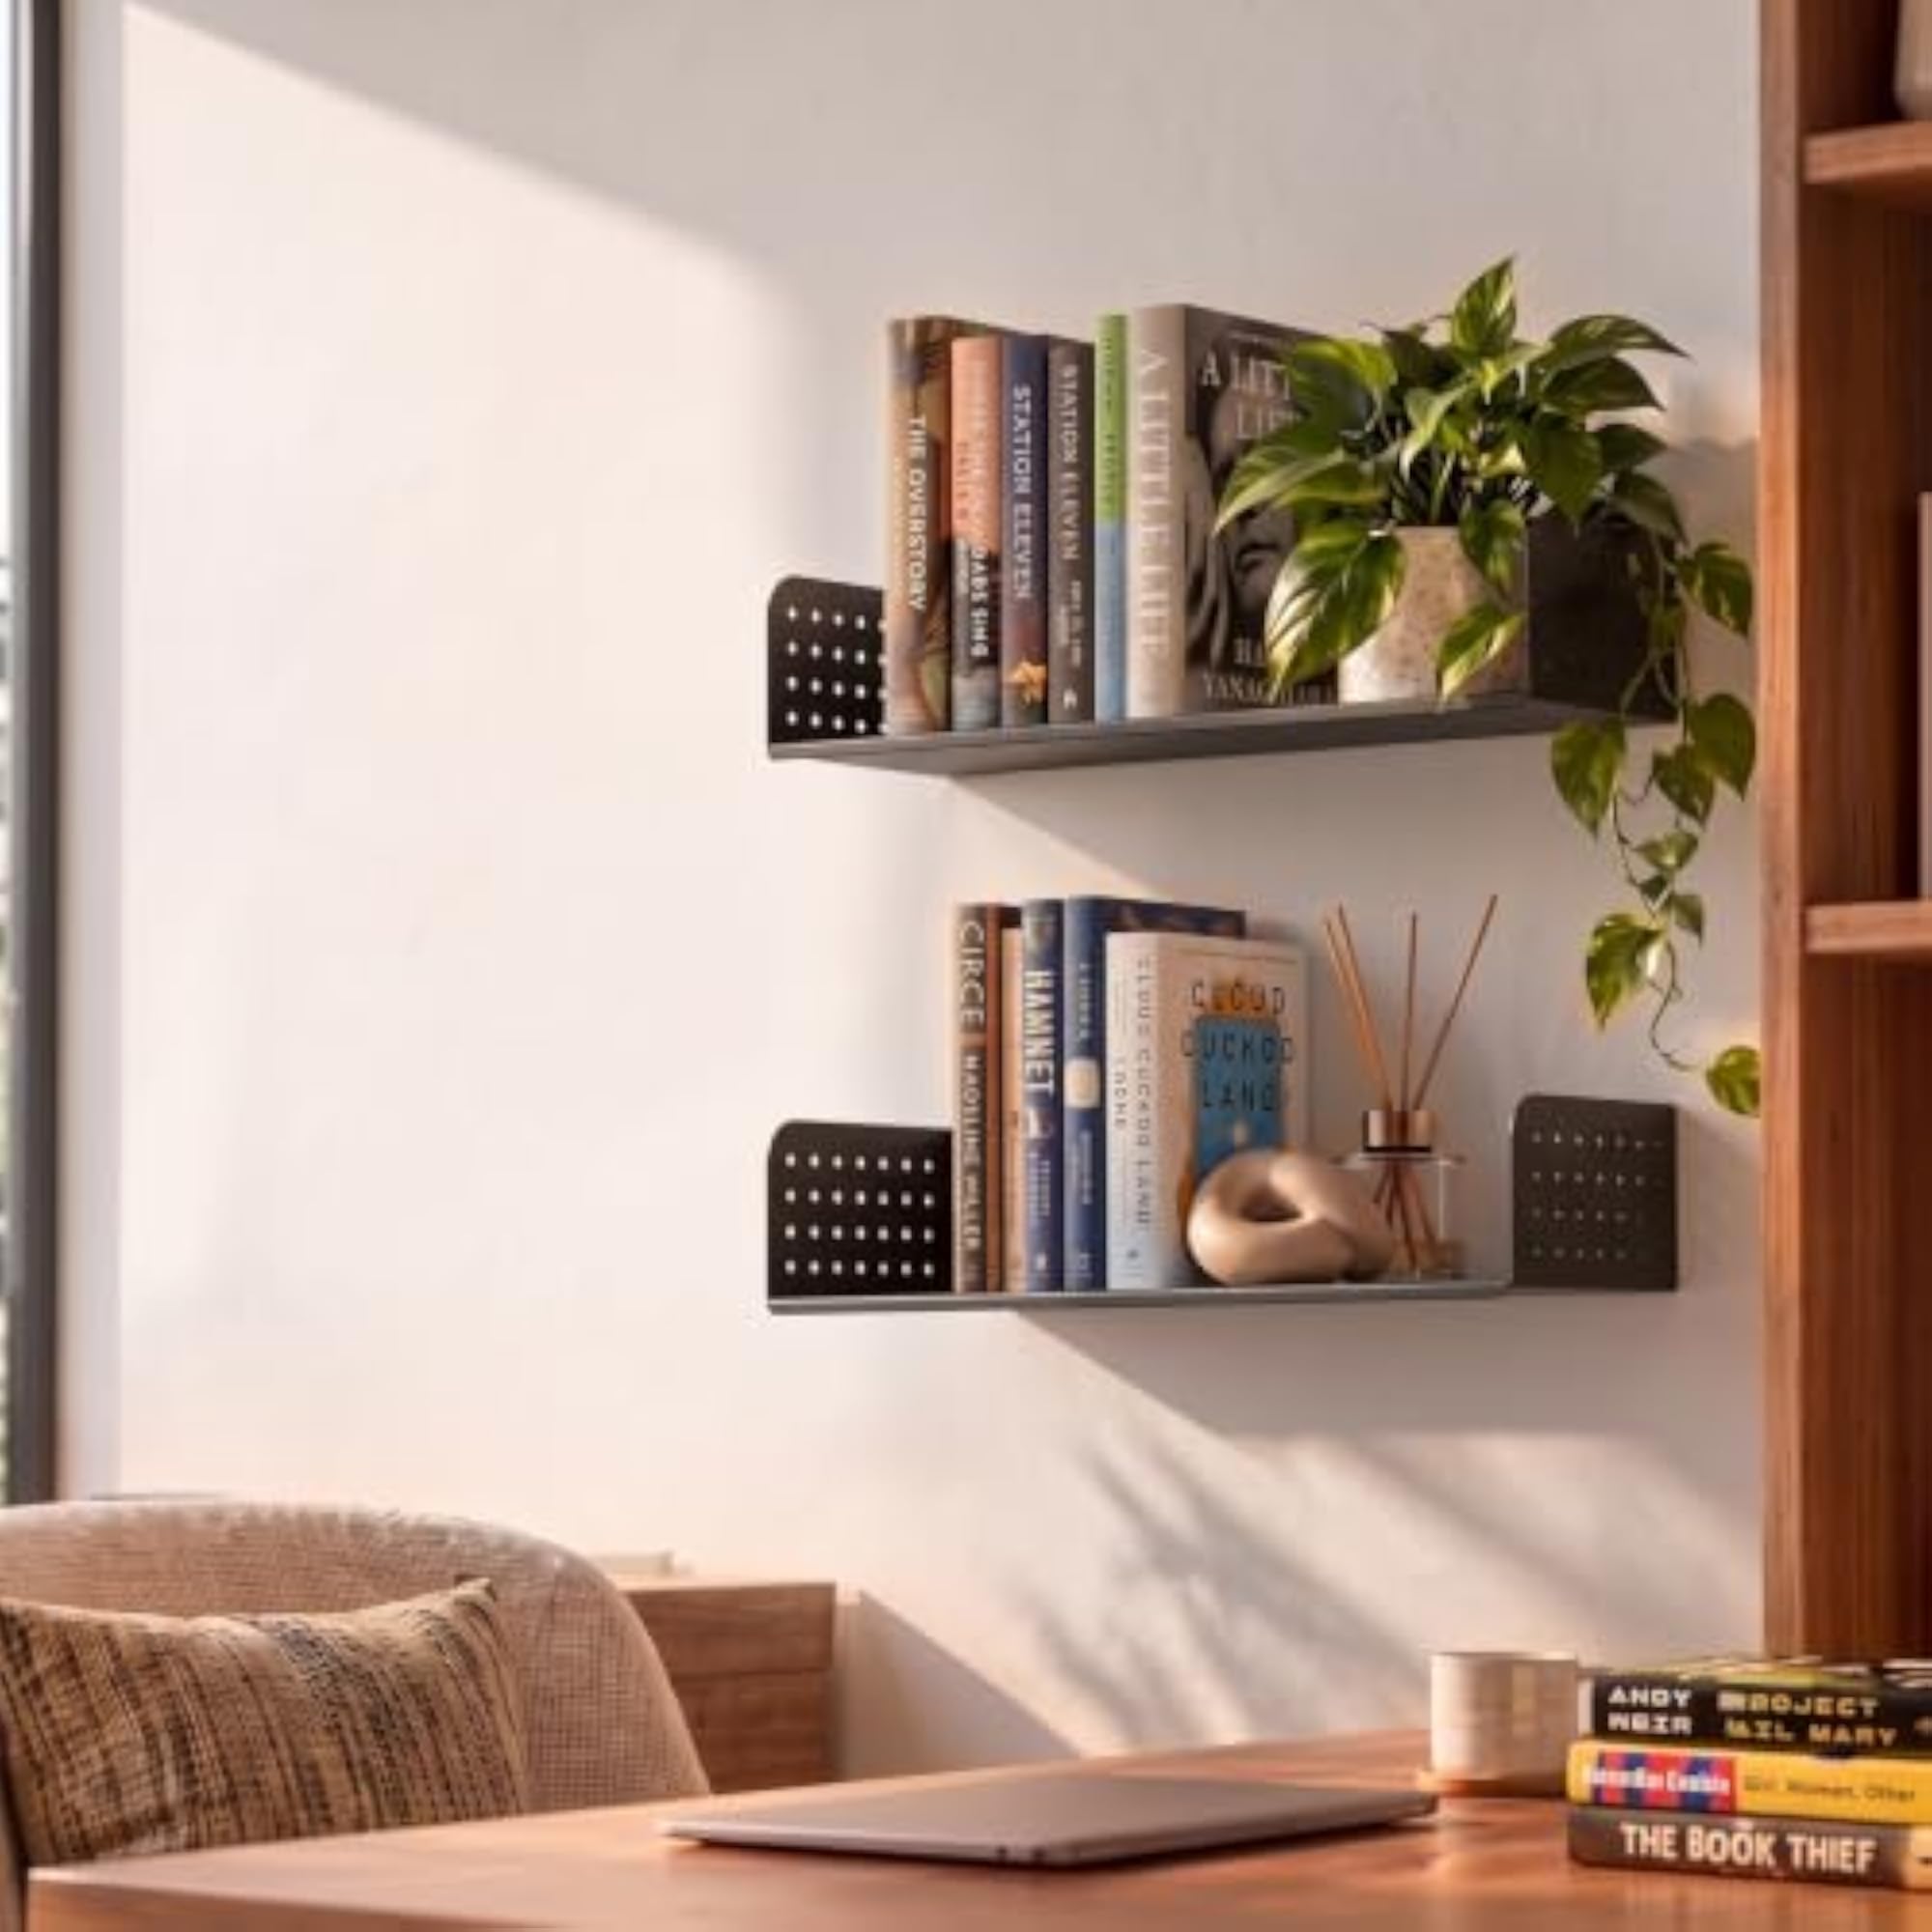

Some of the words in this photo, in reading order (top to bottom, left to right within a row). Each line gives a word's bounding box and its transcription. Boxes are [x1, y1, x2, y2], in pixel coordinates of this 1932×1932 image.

[1060, 363, 1078, 464] STATION
[1200, 351, 1222, 385] A
[908, 415, 926, 459] THE
[1013, 384, 1032, 495] STATION
[908, 468, 927, 612] OVERSTORY
[1014, 502, 1033, 599] ELEVEN
[960, 920, 985, 1026] CIRCE
[1024, 969, 1055, 1095] HAMNET
[1607, 1685, 1692, 1709] ANDY
[1619, 1822, 1677, 1859] THE
[1686, 1825, 1779, 1868] BOOK
[1787, 1834, 1878, 1874] THIEF
